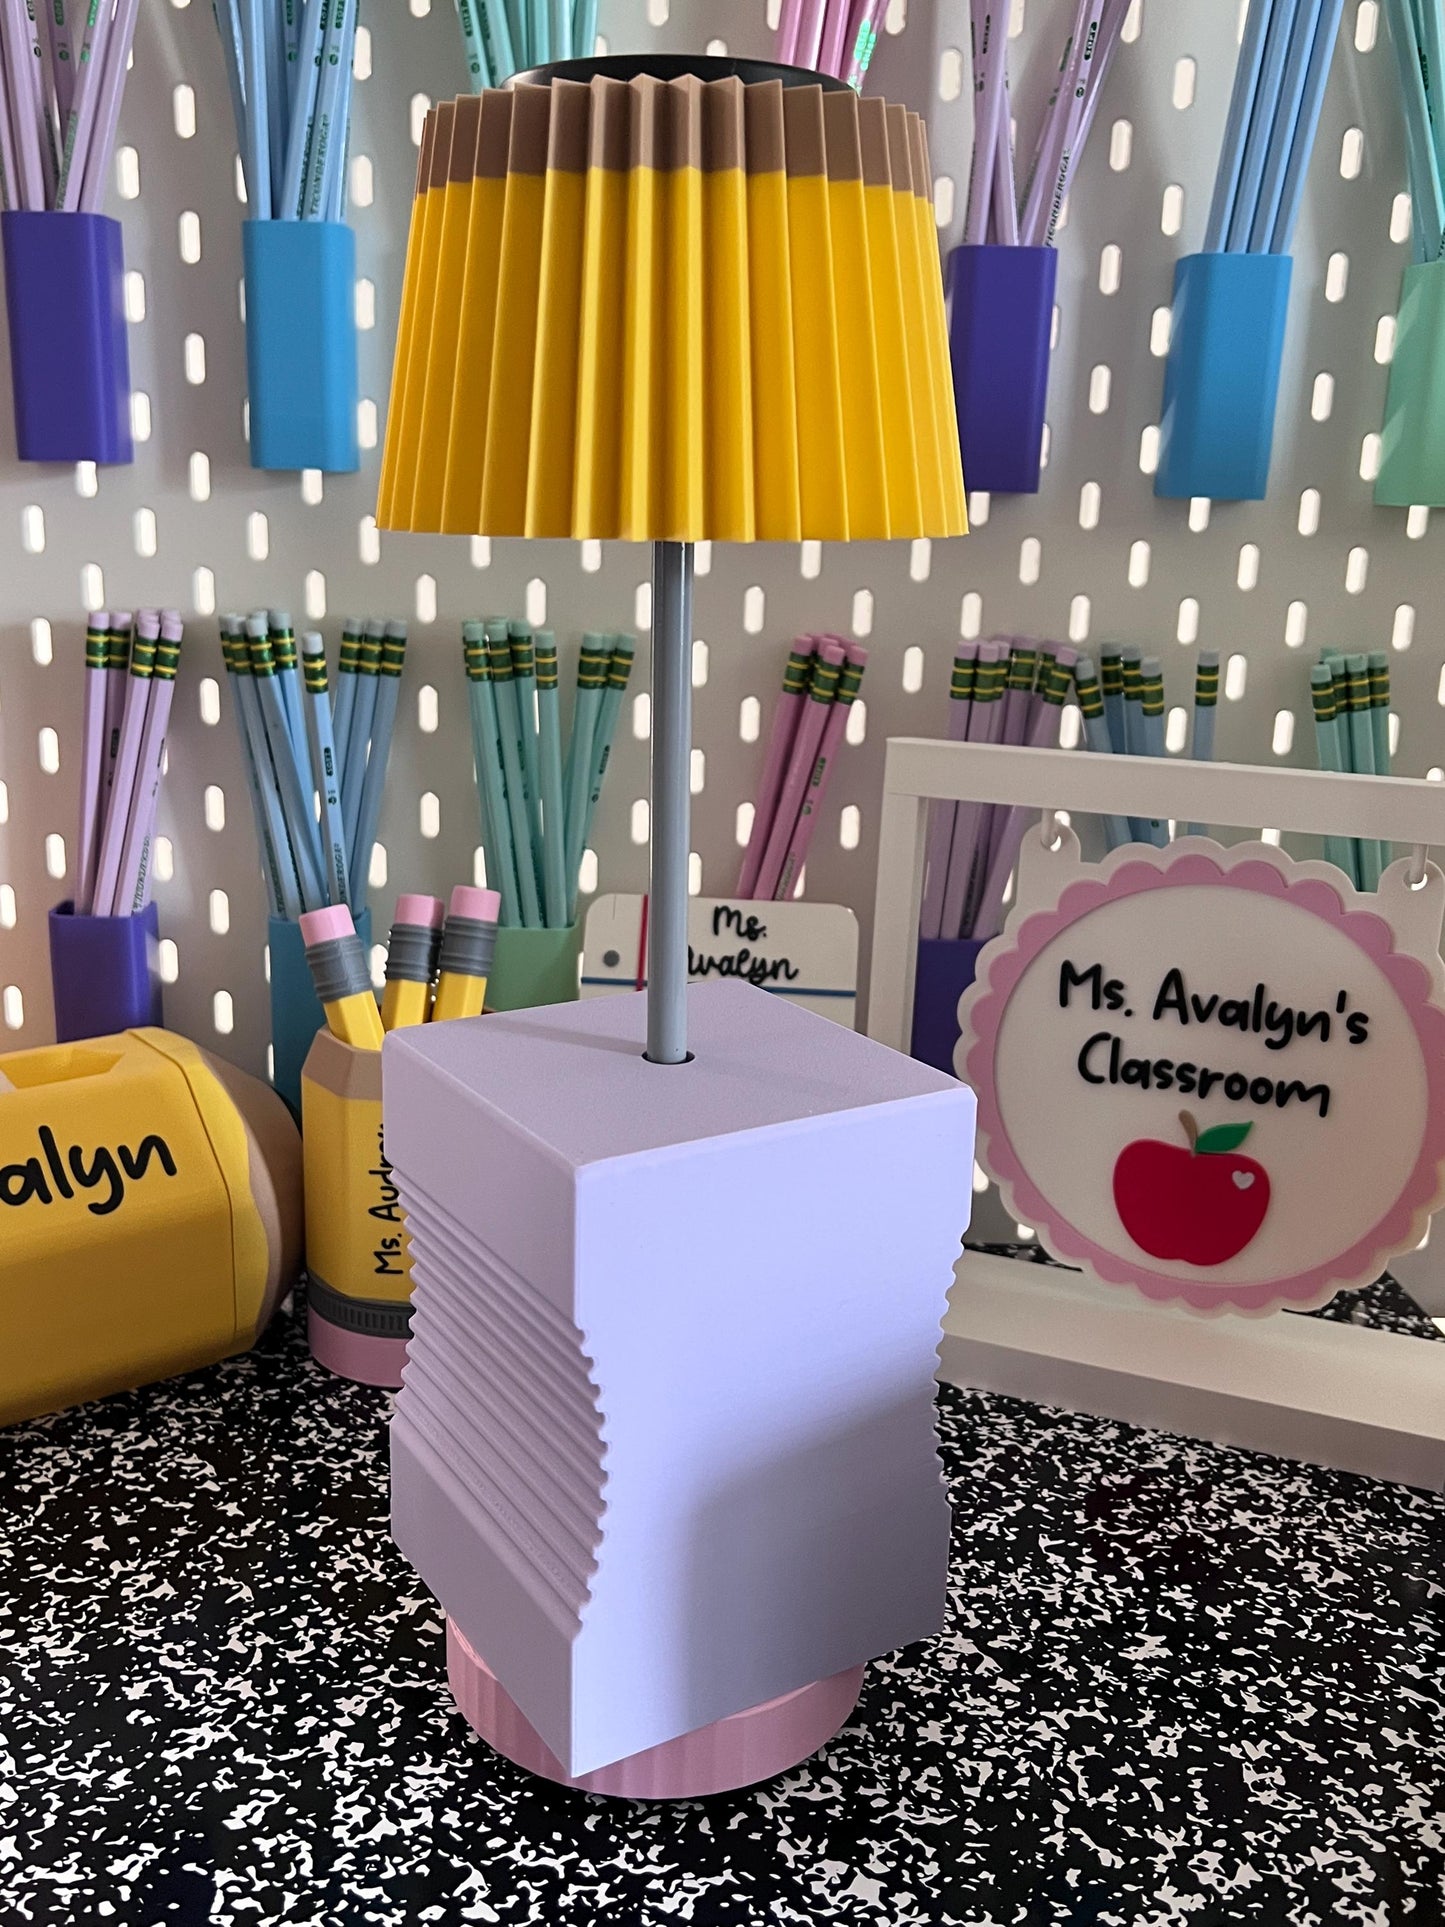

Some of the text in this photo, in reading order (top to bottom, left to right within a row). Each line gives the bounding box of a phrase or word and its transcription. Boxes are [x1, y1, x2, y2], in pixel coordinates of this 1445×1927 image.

[1045, 153, 1070, 248] TICONDEROGA
[713, 905, 767, 941] Ms.
[1059, 959, 1369, 1050] Ms. Avalyn's
[1078, 1031, 1330, 1118] Classroom
[0, 1125, 177, 1215] alyn
[368, 1123, 404, 1275] Ms. Audr
